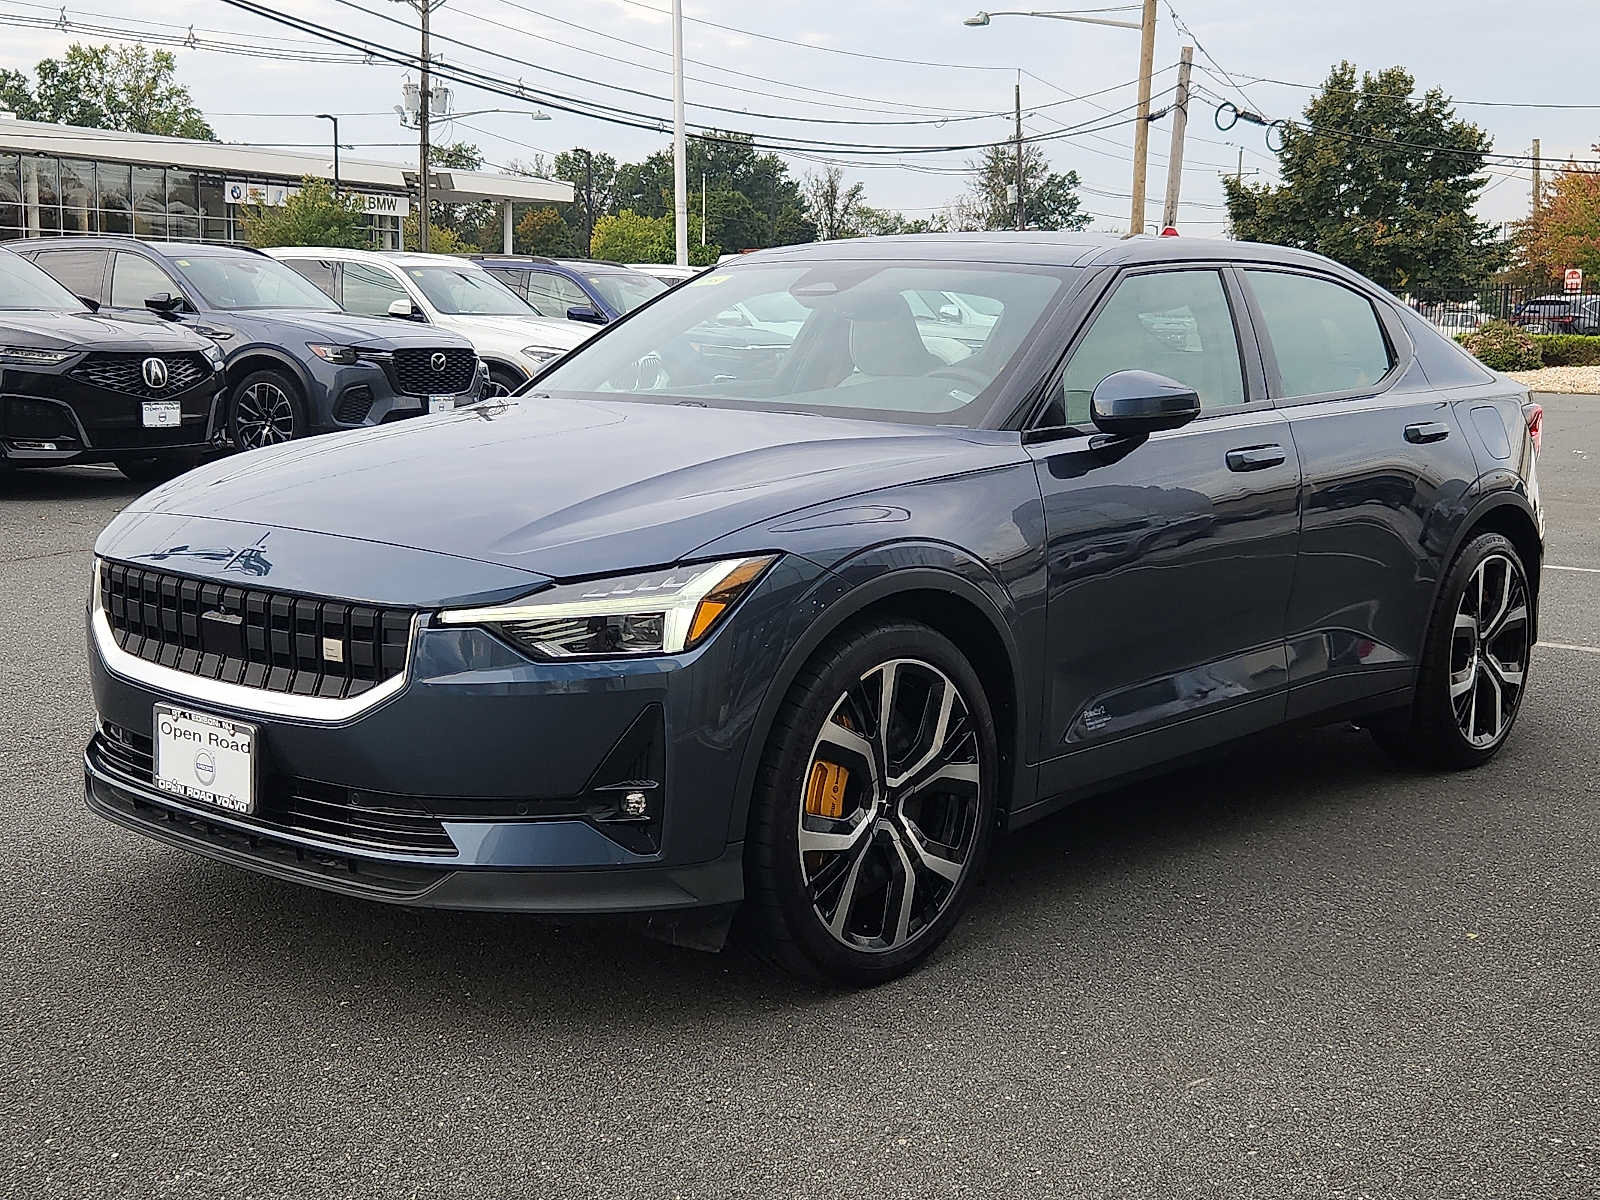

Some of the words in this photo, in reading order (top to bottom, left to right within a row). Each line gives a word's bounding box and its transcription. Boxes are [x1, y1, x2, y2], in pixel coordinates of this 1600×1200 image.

[368, 196, 397, 211] BMW
[161, 721, 202, 743] Open
[208, 732, 251, 754] Road
[158, 779, 185, 795] OPEN
[186, 786, 214, 802] ROAD
[215, 795, 247, 813] VOLVO
